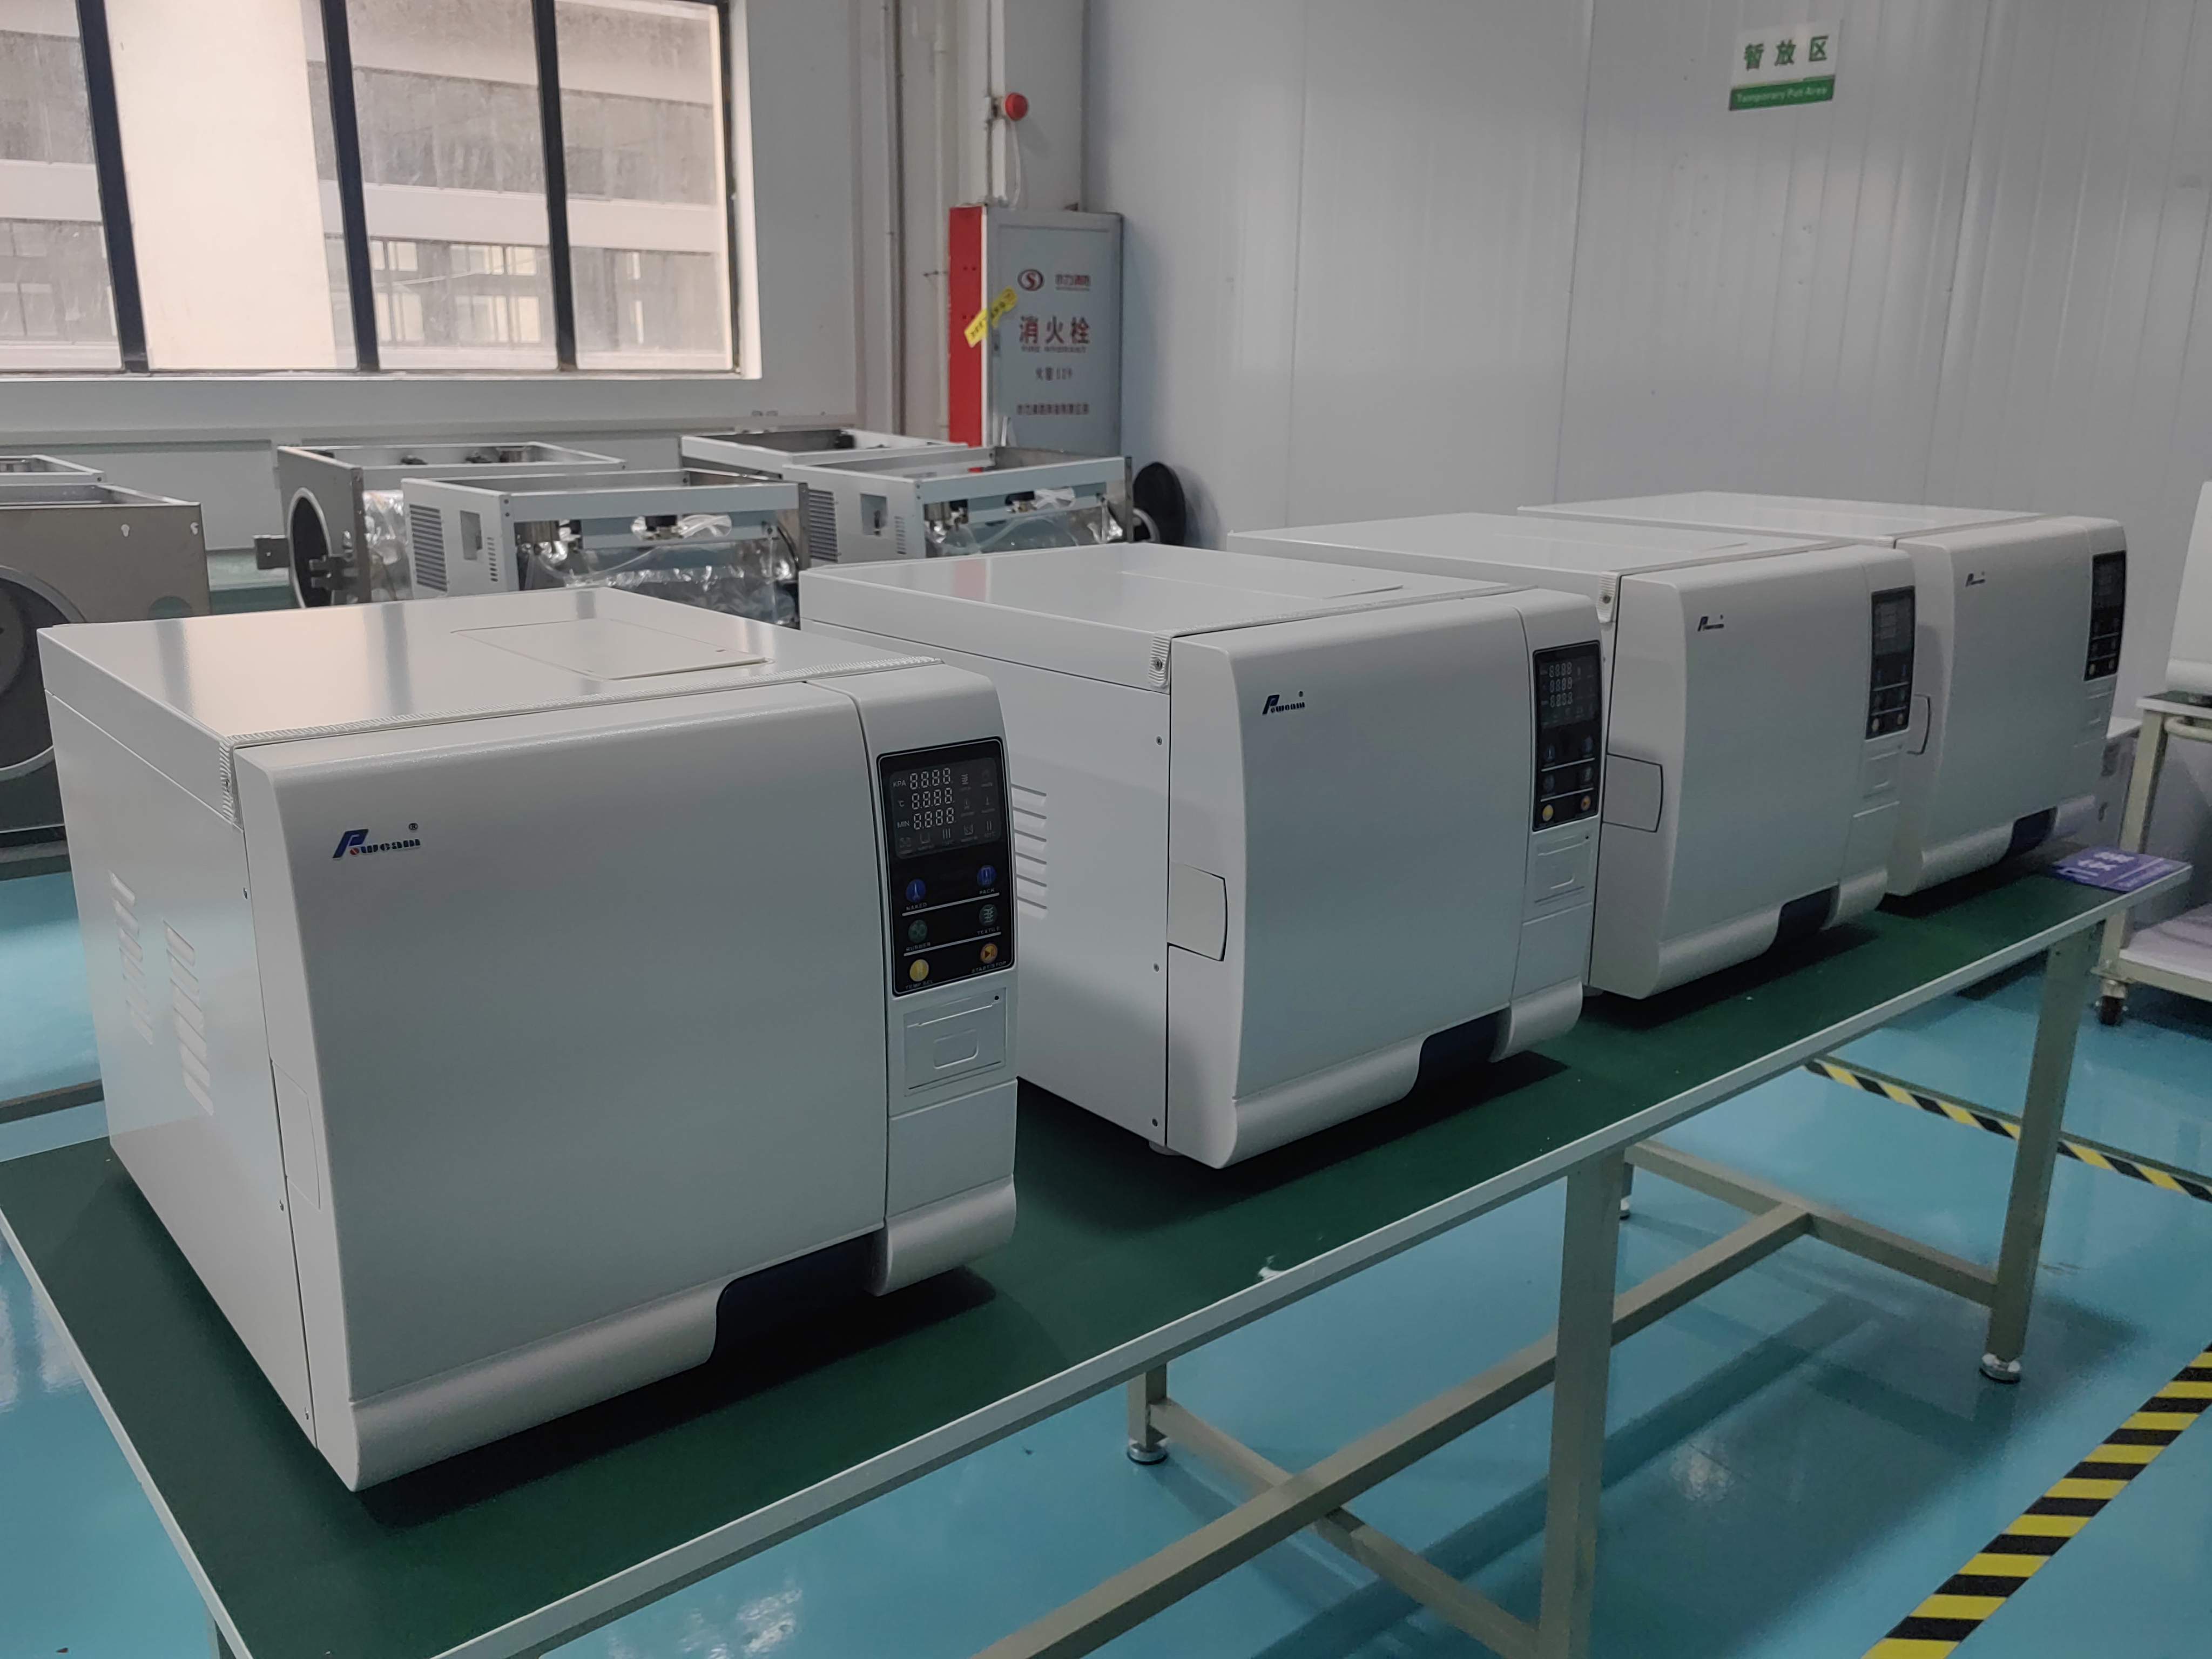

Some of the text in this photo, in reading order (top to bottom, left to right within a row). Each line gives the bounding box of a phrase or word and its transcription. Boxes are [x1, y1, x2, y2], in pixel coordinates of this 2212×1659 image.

[1019, 315, 1090, 345] 消火栓
[906, 902, 928, 911] NAKED
[976, 926, 1001, 935] TEXTILE
[906, 942, 931, 952] RUBBER
